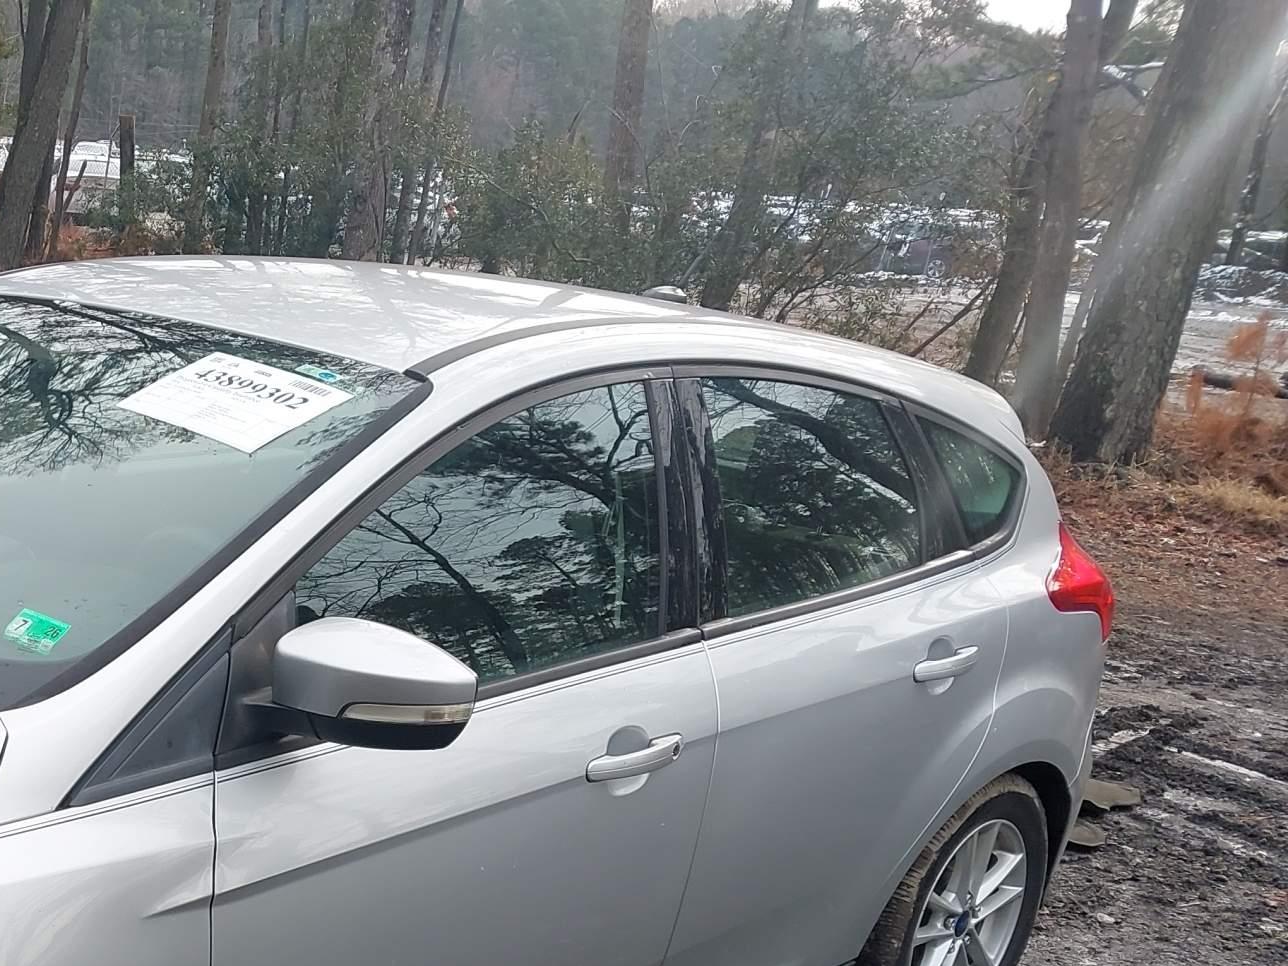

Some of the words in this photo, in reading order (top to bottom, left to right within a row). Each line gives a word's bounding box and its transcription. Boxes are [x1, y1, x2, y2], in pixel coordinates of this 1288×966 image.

[194, 369, 310, 410] 43899302
[15, 619, 29, 631] 7
[44, 625, 62, 638] 26
